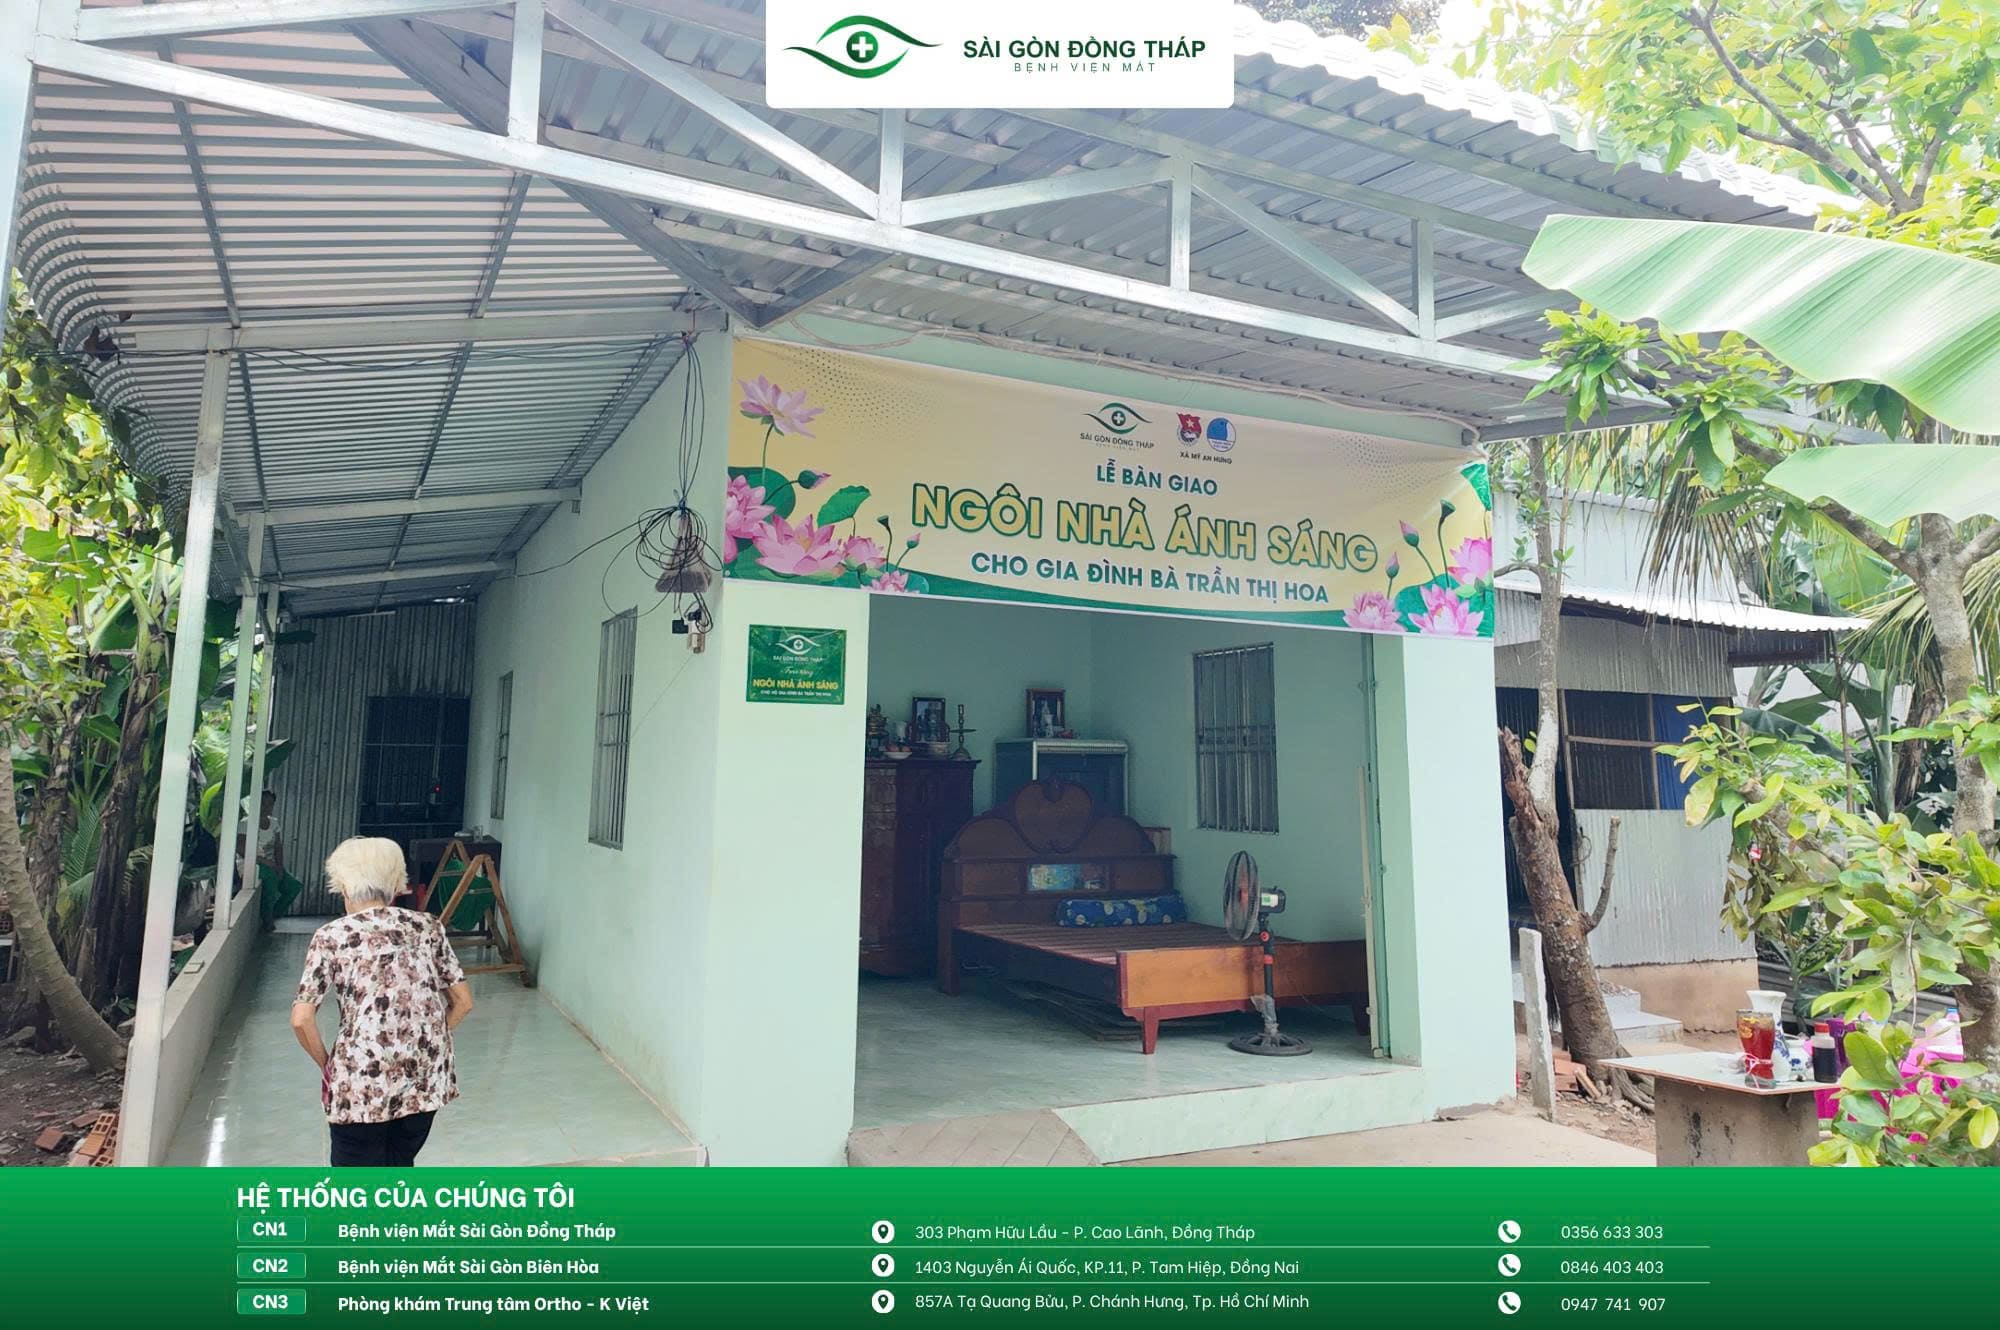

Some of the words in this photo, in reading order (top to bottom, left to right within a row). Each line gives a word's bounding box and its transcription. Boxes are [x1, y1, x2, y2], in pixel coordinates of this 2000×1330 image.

[1097, 459, 1116, 483] LỄ
[1122, 466, 1162, 489] BÀN
[1168, 474, 1218, 496] GIAO
[912, 483, 1043, 538] NGÔI
[1057, 497, 1155, 550] NHÀ
[1165, 503, 1256, 561] ÁNH
[1267, 518, 1378, 572] SÁNG
[971, 552, 1028, 576] CHO
[1036, 558, 1079, 581] GIA
[1087, 559, 1143, 586] ĐÌNH
[1151, 565, 1179, 590] BÀ
[1186, 566, 1240, 595] TRẦN
[1247, 579, 1277, 603] THỊ
[1284, 581, 1329, 603] HOA
[752, 678, 776, 688] NGÔI
[777, 679, 795, 689] NHÀ
[796, 679, 814, 690] ÁNH
[816, 680, 839, 690] SÁNG
